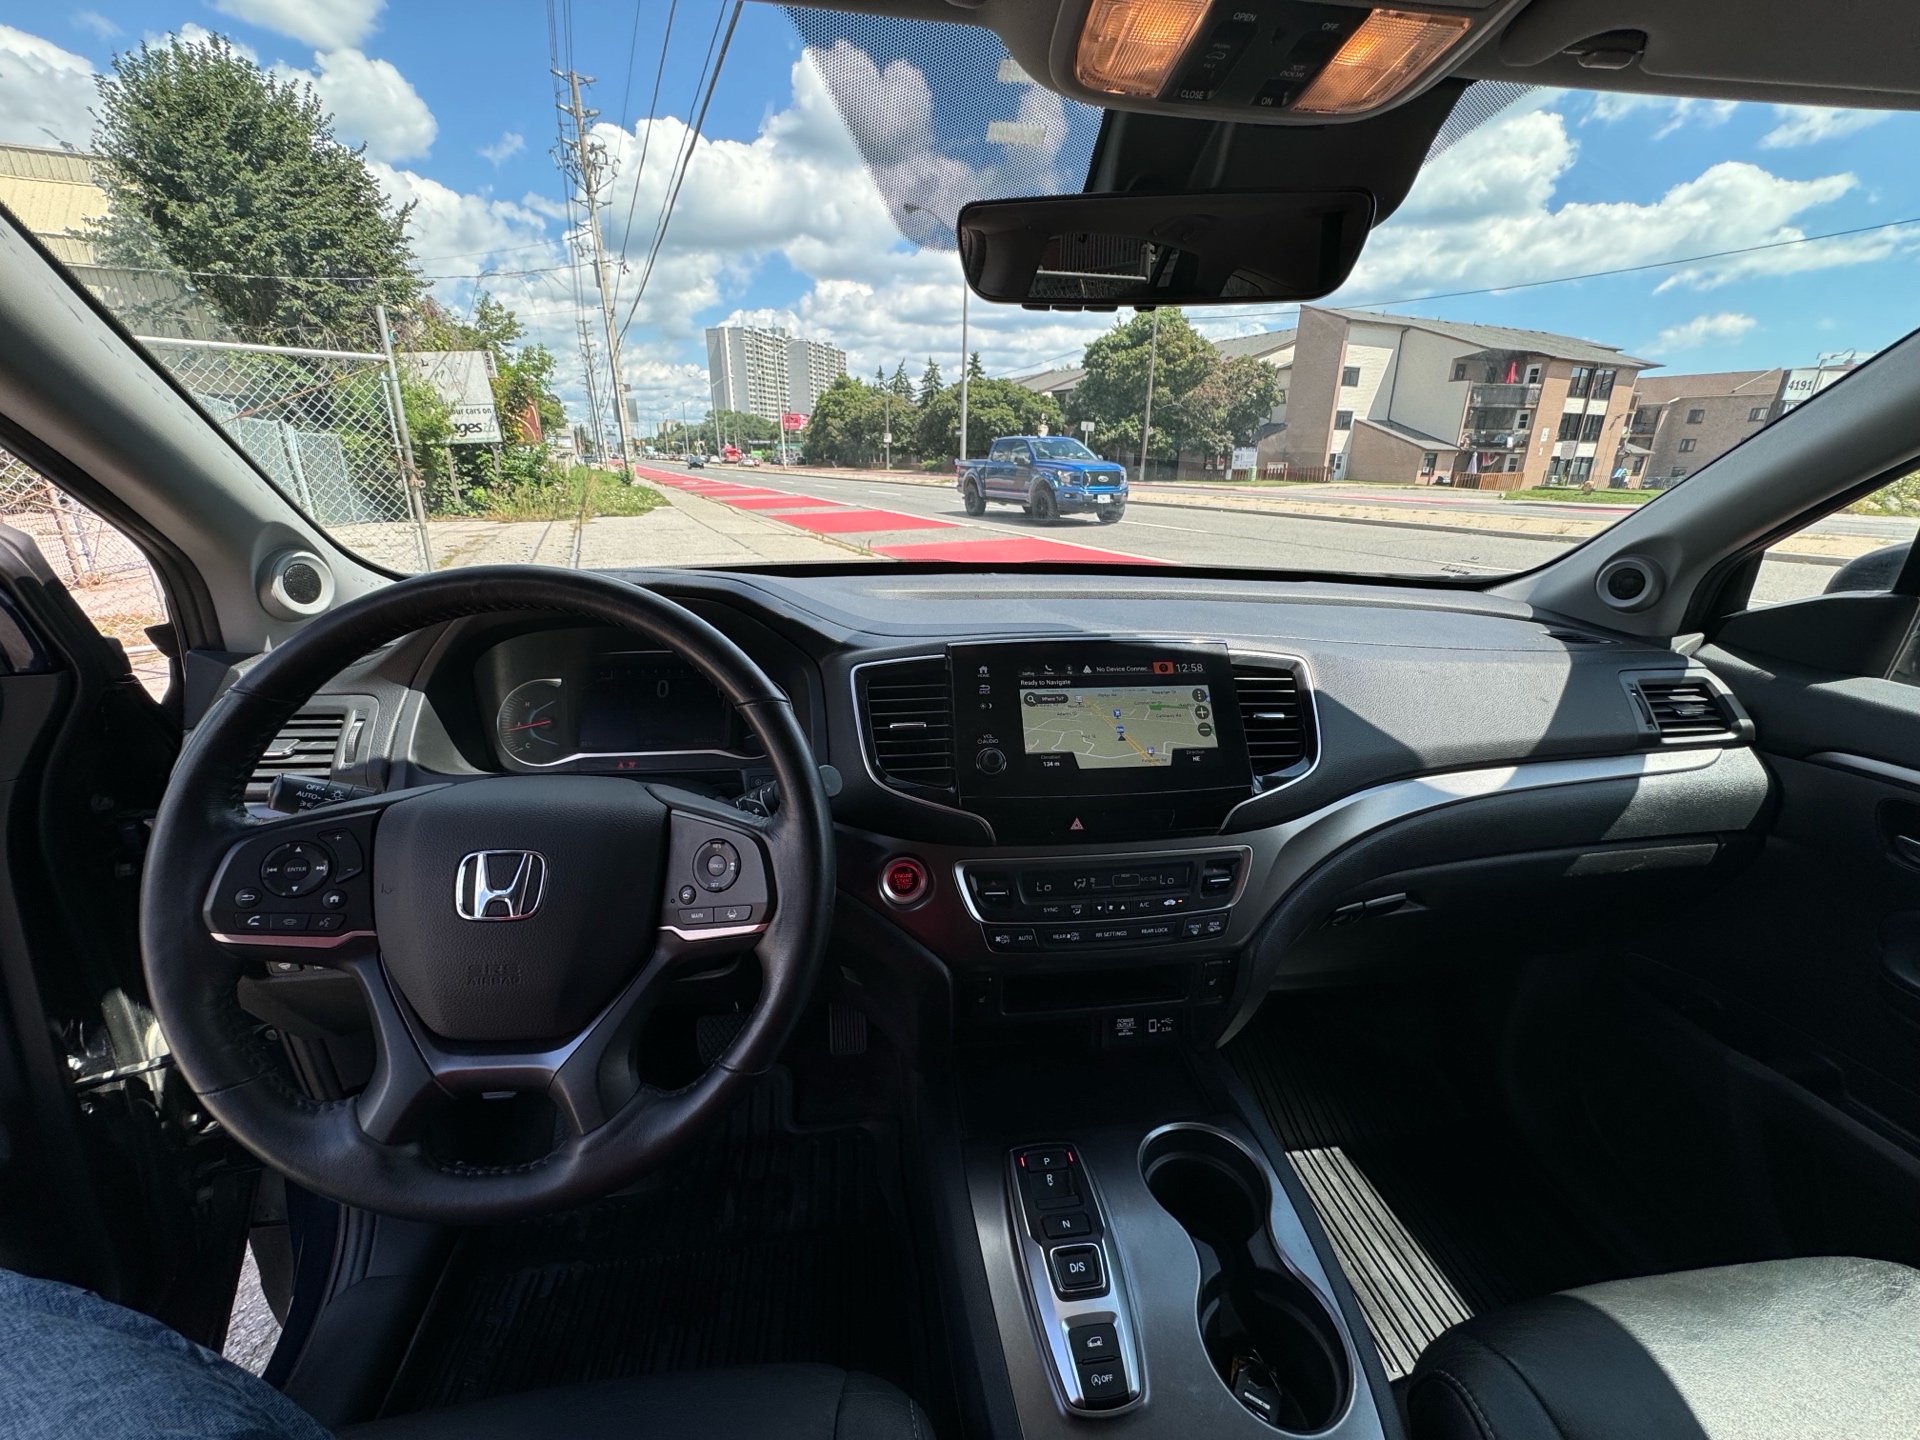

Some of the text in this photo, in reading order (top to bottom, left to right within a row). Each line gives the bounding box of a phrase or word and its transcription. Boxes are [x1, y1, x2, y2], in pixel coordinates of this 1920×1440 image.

[1233, 12, 1257, 22] OPEN
[1322, 22, 1340, 31] OFF
[1280, 70, 1305, 78] DOOR
[1181, 89, 1204, 100] CLOSE
[1261, 96, 1273, 106] ON
[1788, 380, 1813, 391] 4191
[465, 407, 481, 415] cars
[1176, 663, 1203, 673] 12:58
[1020, 679, 1038, 687] Ready
[1046, 679, 1071, 687] Navigate
[656, 679, 670, 698] 0
[306, 783, 321, 791] OFF
[295, 790, 318, 800] AUTO
[1043, 1157, 1051, 1166] P
[1046, 1173, 1054, 1183] R
[1061, 1219, 1071, 1229] N
[1069, 1261, 1086, 1273] D/S
[1101, 1373, 1113, 1383] OFF
